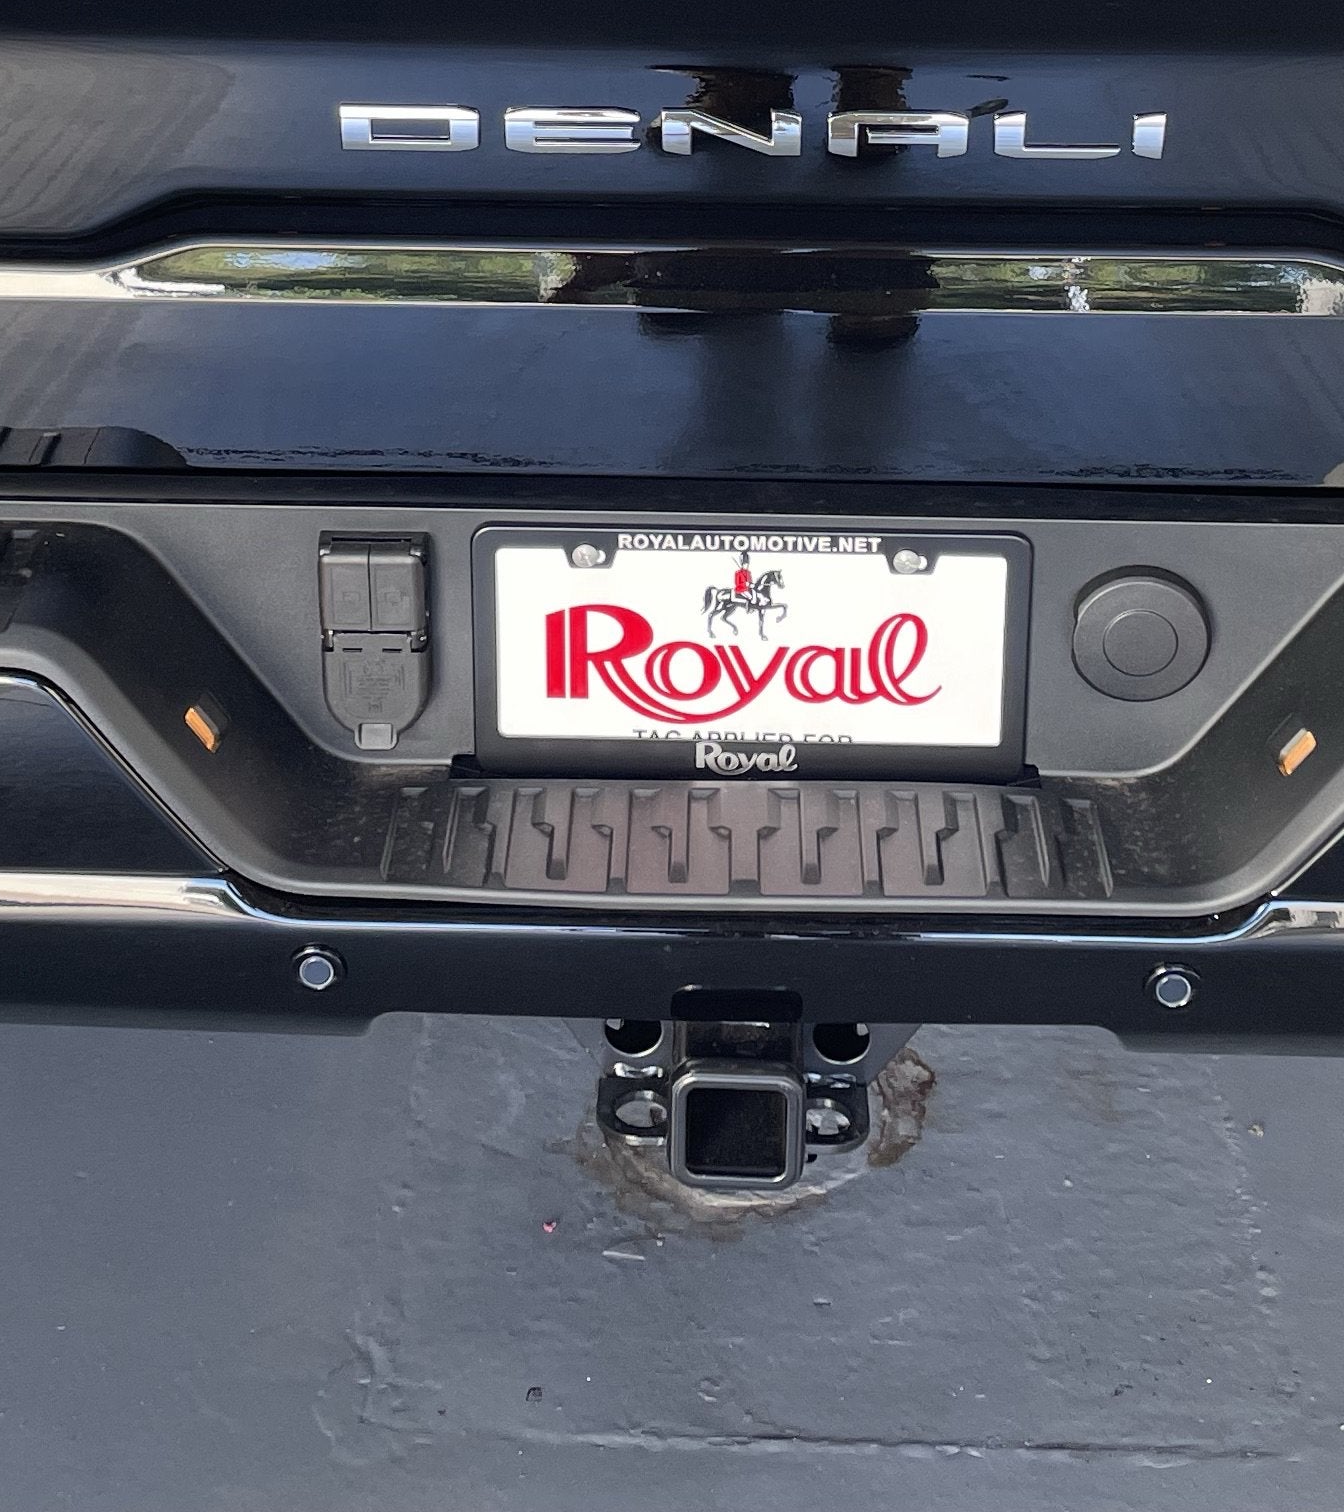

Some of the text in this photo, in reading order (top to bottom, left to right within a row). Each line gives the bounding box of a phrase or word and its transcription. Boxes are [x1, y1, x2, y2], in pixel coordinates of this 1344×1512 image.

[338, 101, 1167, 159] DENALI
[617, 533, 882, 553] ROYALAUTOMOTIVE.NET
[545, 604, 943, 725] Royal
[695, 741, 798, 776] Royal
